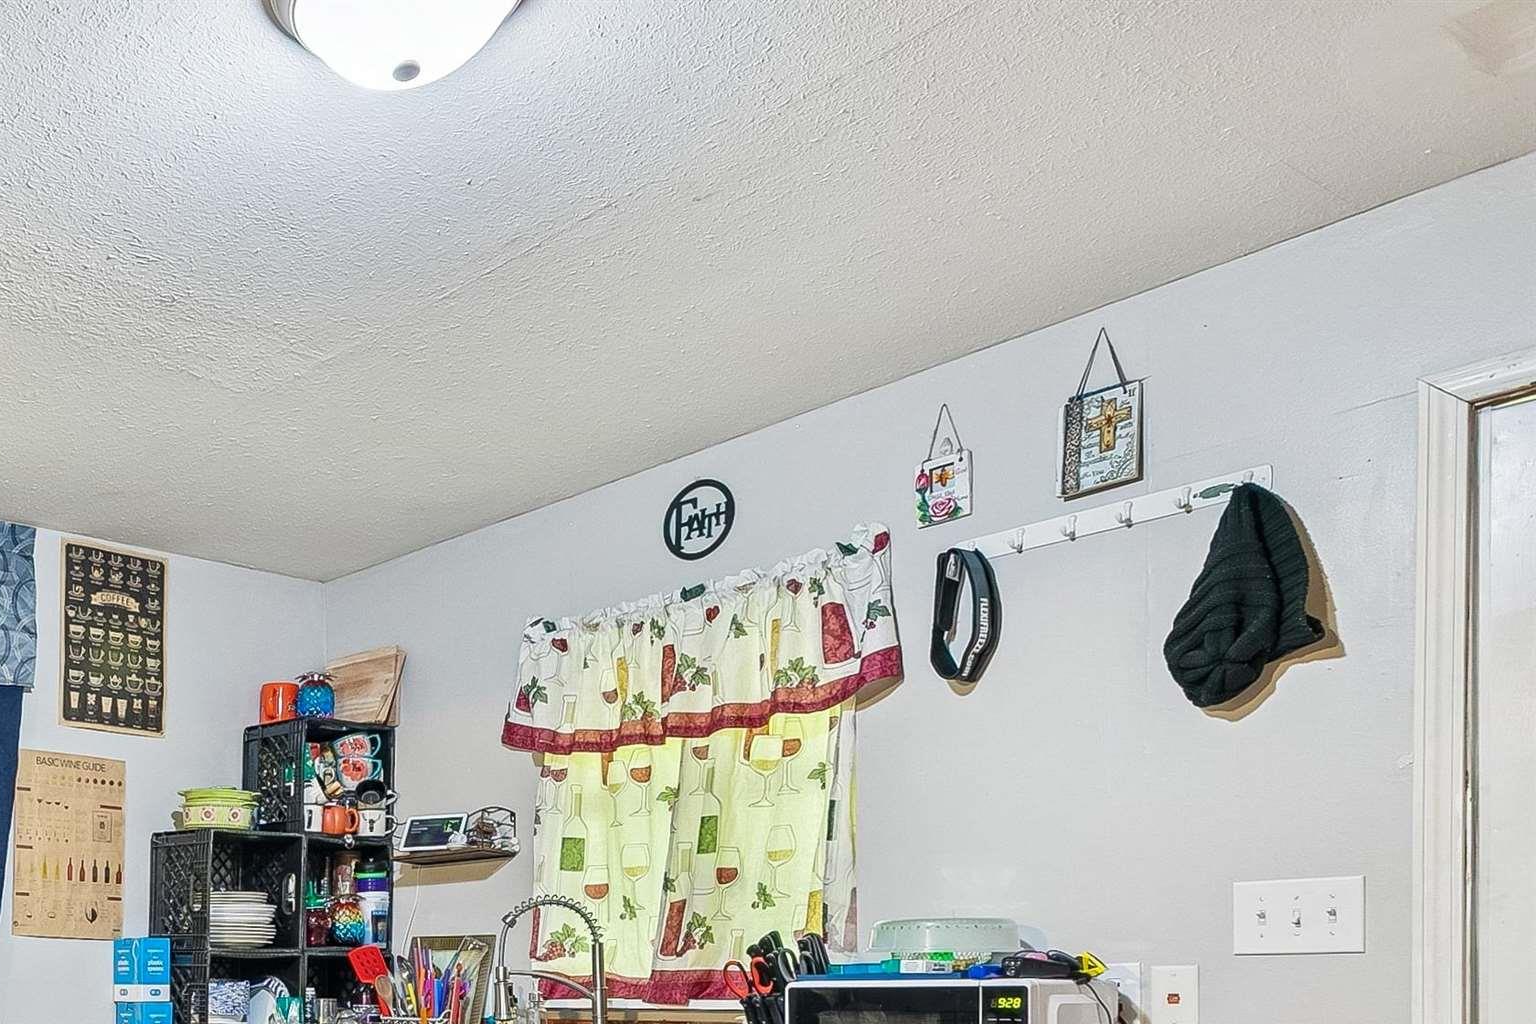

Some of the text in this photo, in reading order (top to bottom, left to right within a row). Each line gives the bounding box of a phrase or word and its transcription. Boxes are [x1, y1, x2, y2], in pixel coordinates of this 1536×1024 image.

[671, 496, 730, 551] FAITH
[100, 593, 132, 607] COFFEE
[35, 756, 107, 773] BASIC WINE GUIDE
